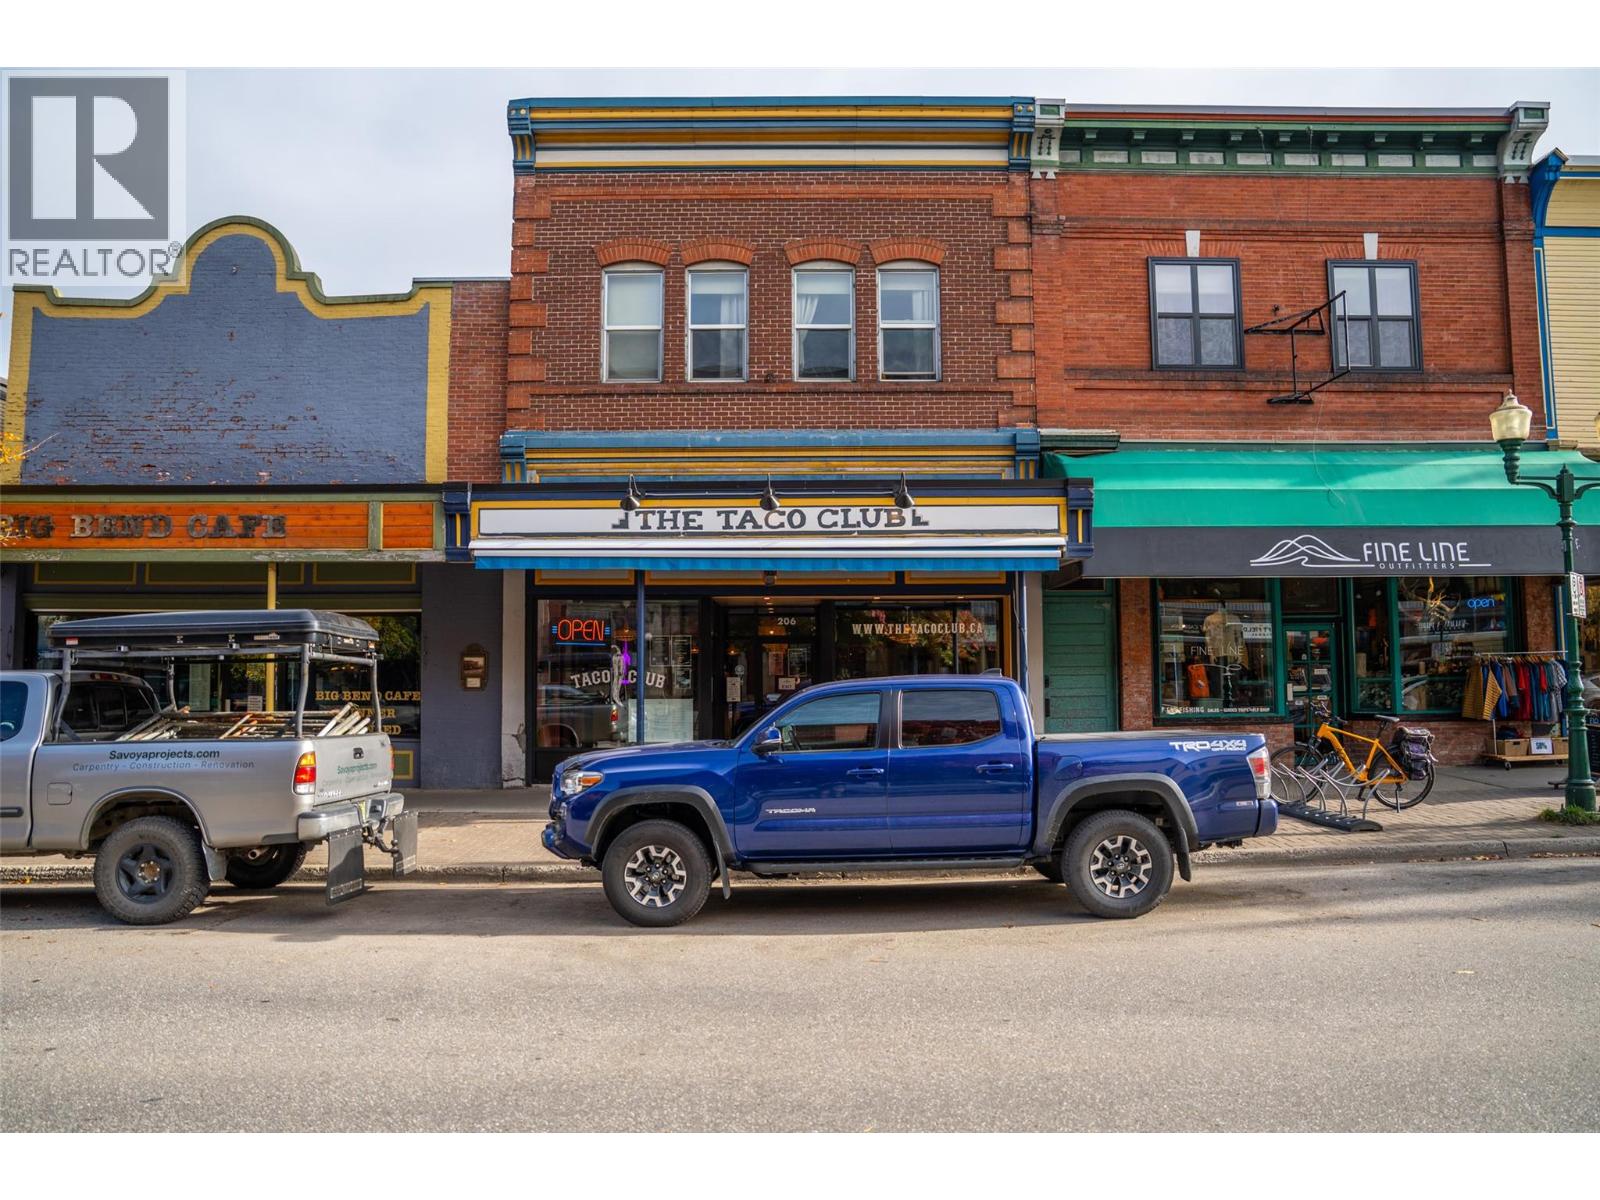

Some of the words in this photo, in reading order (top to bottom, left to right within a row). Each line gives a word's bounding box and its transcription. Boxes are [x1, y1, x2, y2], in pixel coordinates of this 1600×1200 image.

[635, 510, 703, 530] THE
[717, 509, 806, 529] TACO
[817, 508, 907, 528] CLUB
[70, 514, 173, 538] BEND
[187, 513, 287, 538] CAFE
[1363, 542, 1412, 562] FINE
[1418, 542, 1470, 562] LINE
[1379, 562, 1455, 570] OUTFITTERS
[1466, 598, 1495, 609] open
[777, 617, 797, 626] 206
[557, 619, 605, 641] OPEN
[852, 622, 983, 635] WWW.THETACOCLUB.CA
[1190, 645, 1214, 656] FINE
[570, 669, 611, 688] TACO
[628, 669, 666, 688] CUB
[315, 690, 340, 701] BIG
[342, 690, 382, 701] BEN
[384, 690, 421, 701] CAFE
[109, 749, 220, 761] Savoyaprojects.com
[72, 762, 119, 772] Carpentry
[129, 761, 191, 770] Construction
[200, 760, 255, 769] Renovation
